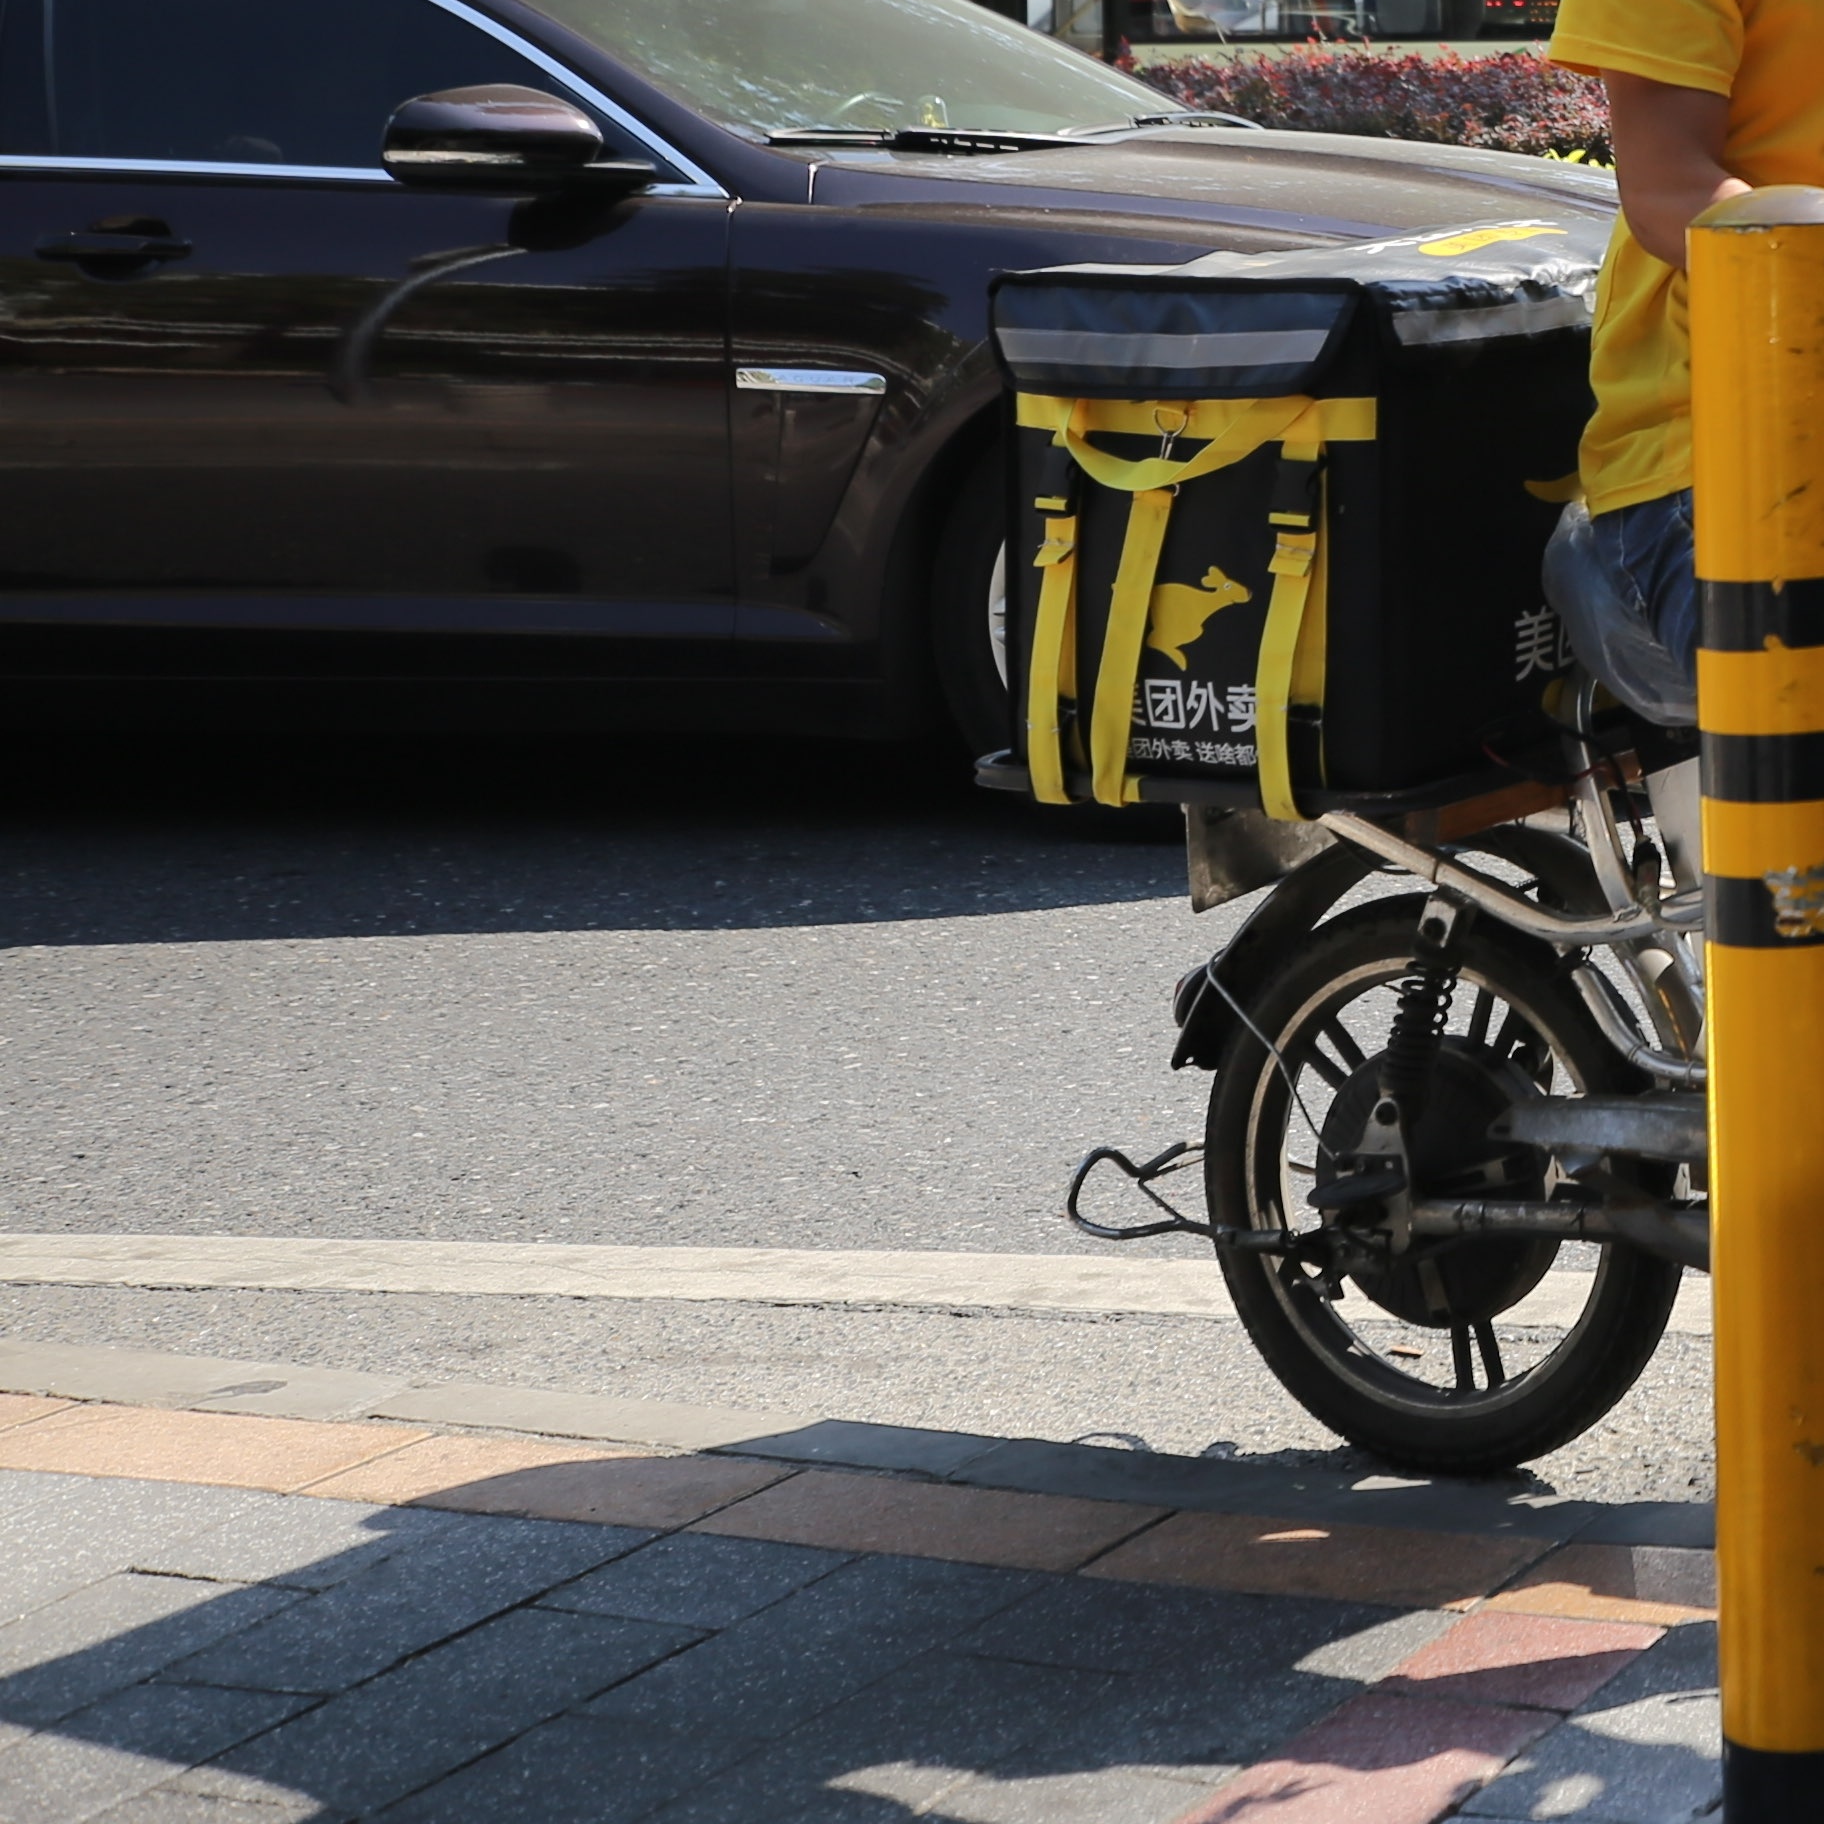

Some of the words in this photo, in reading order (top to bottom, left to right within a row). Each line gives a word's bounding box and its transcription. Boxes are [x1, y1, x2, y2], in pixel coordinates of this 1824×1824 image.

[1132, 679, 1257, 733] 团外卖
[1195, 740, 1259, 767] 送啥都
